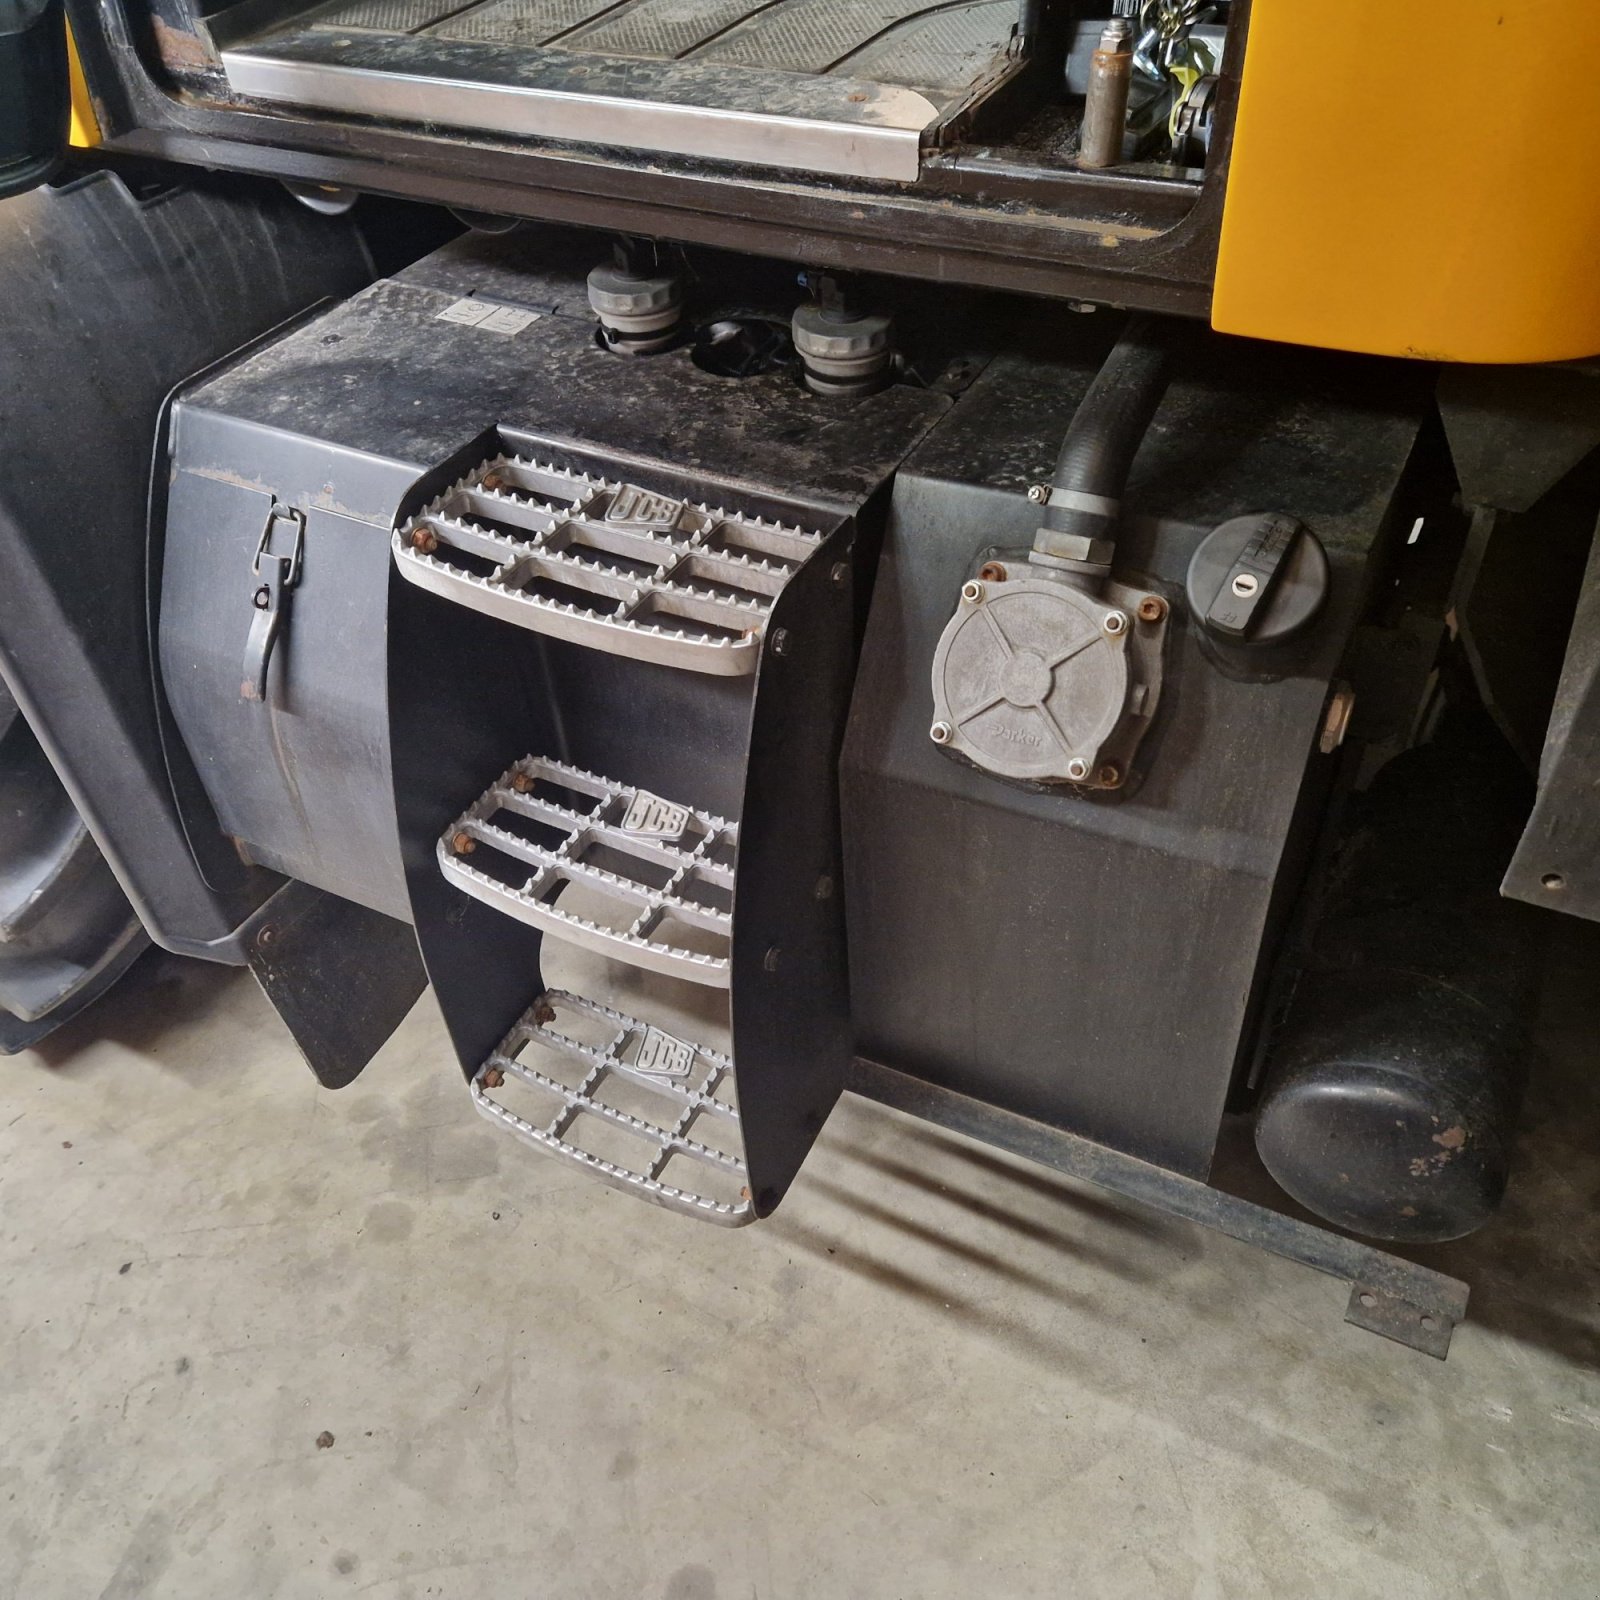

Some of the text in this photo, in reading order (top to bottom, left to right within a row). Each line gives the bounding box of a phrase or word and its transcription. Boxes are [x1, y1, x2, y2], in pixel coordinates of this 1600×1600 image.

[609, 487, 679, 522] JCB
[625, 796, 685, 833] JCB
[636, 1030, 690, 1072] JCB
